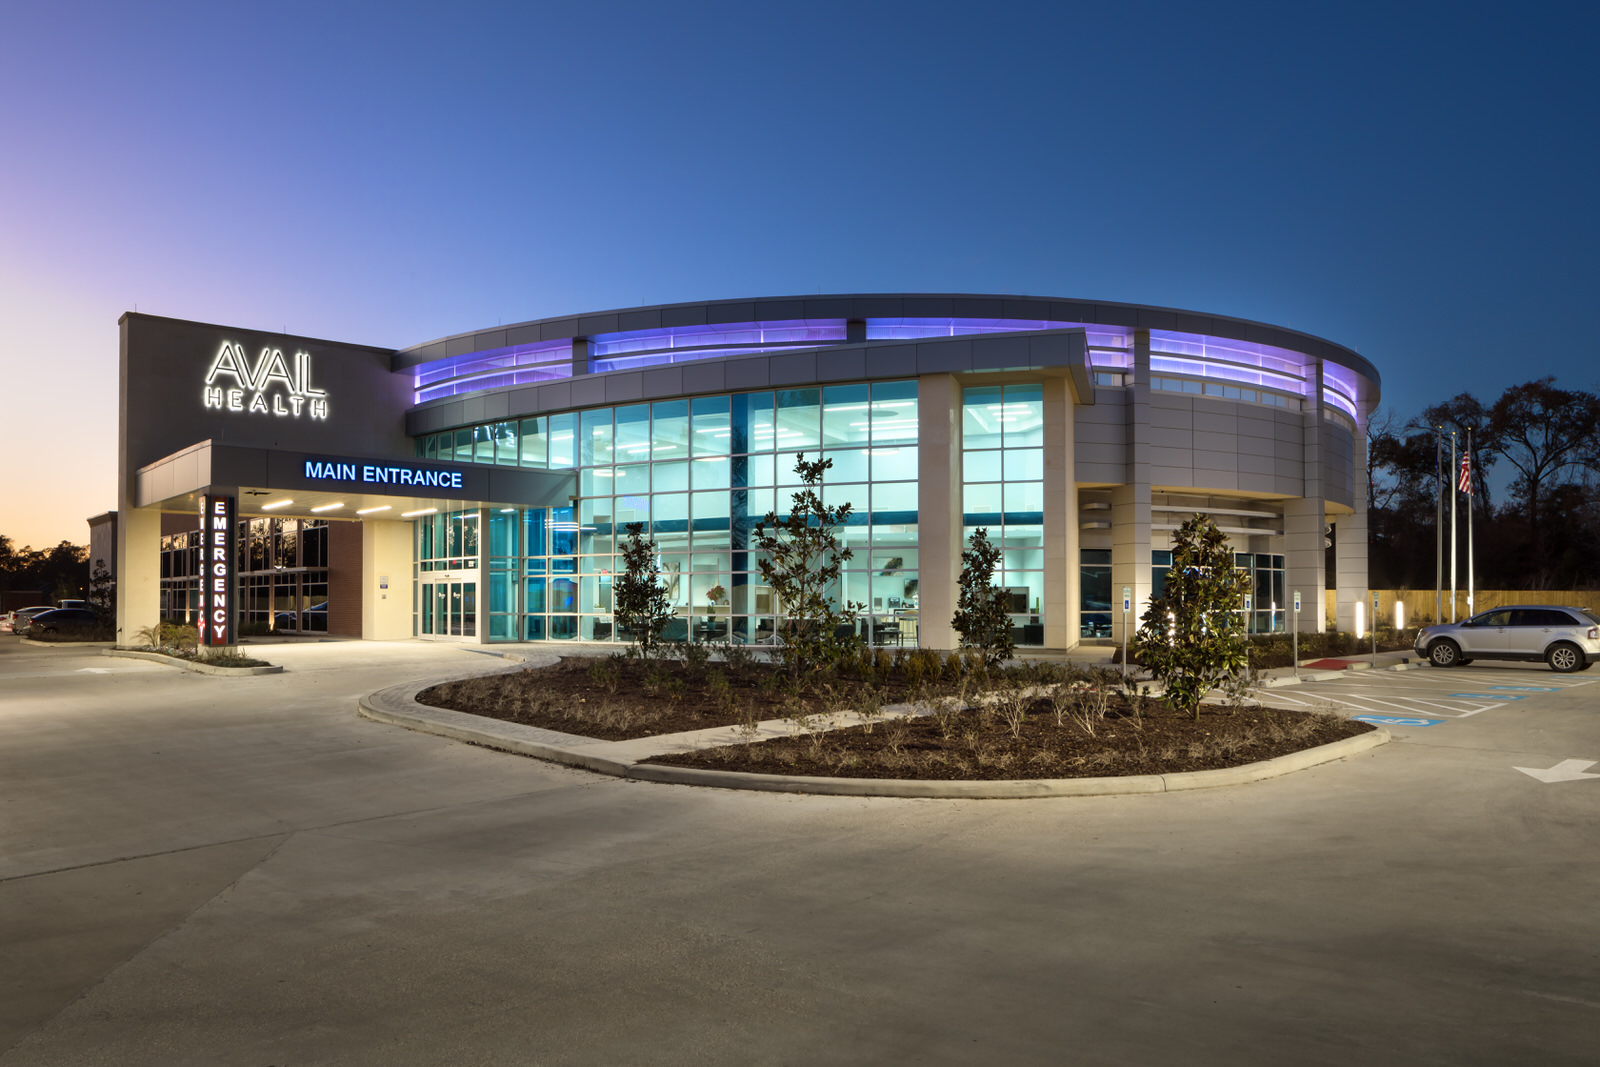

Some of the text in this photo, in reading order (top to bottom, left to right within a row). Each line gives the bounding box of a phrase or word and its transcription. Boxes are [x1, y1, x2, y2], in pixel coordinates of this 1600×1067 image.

[206, 342, 327, 398] AVAIL
[204, 386, 328, 419] HEALTH
[304, 461, 463, 488] MAIN ENTRANCE
[213, 501, 227, 639] EMERGENCY
